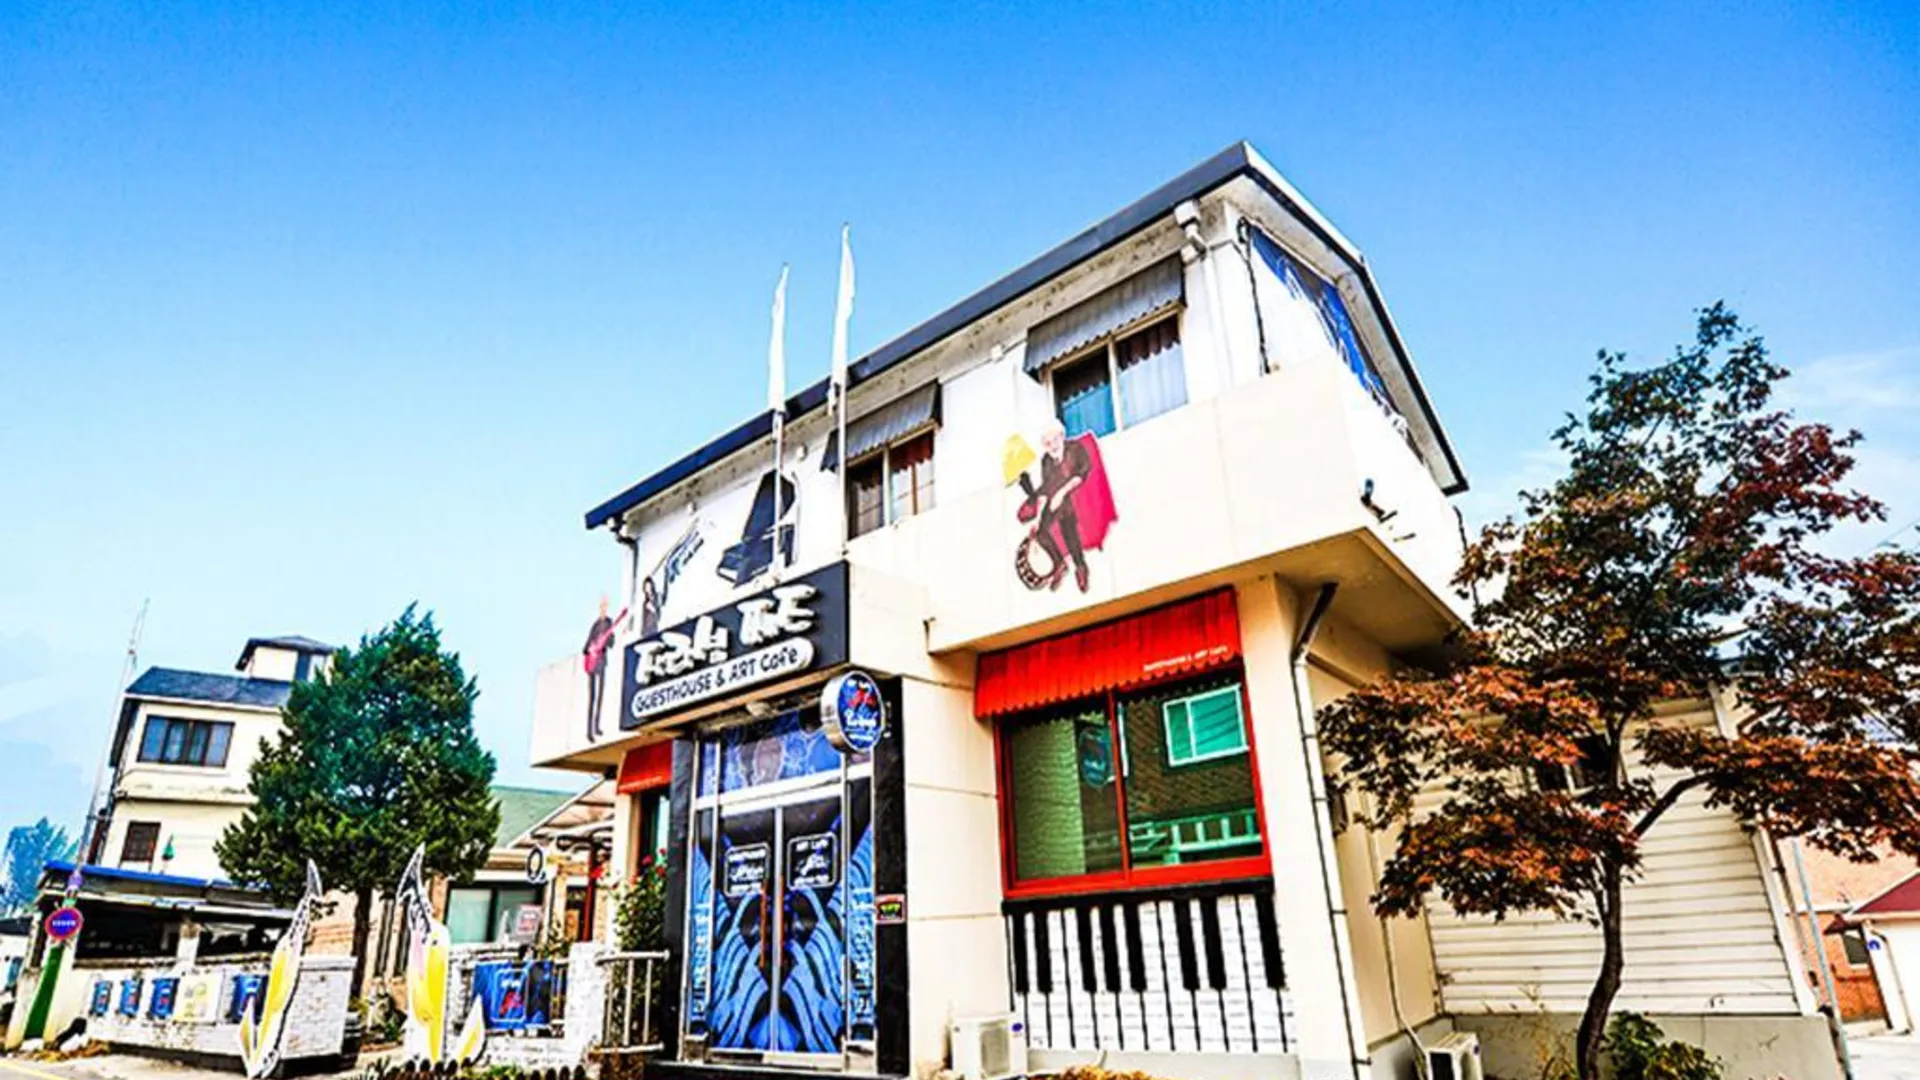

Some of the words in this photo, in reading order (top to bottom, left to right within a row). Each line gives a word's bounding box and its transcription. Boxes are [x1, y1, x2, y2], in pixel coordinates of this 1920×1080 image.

[634, 675, 711, 713] GUESTHOUSE
[716, 668, 726, 688] &
[729, 659, 757, 682] ART
